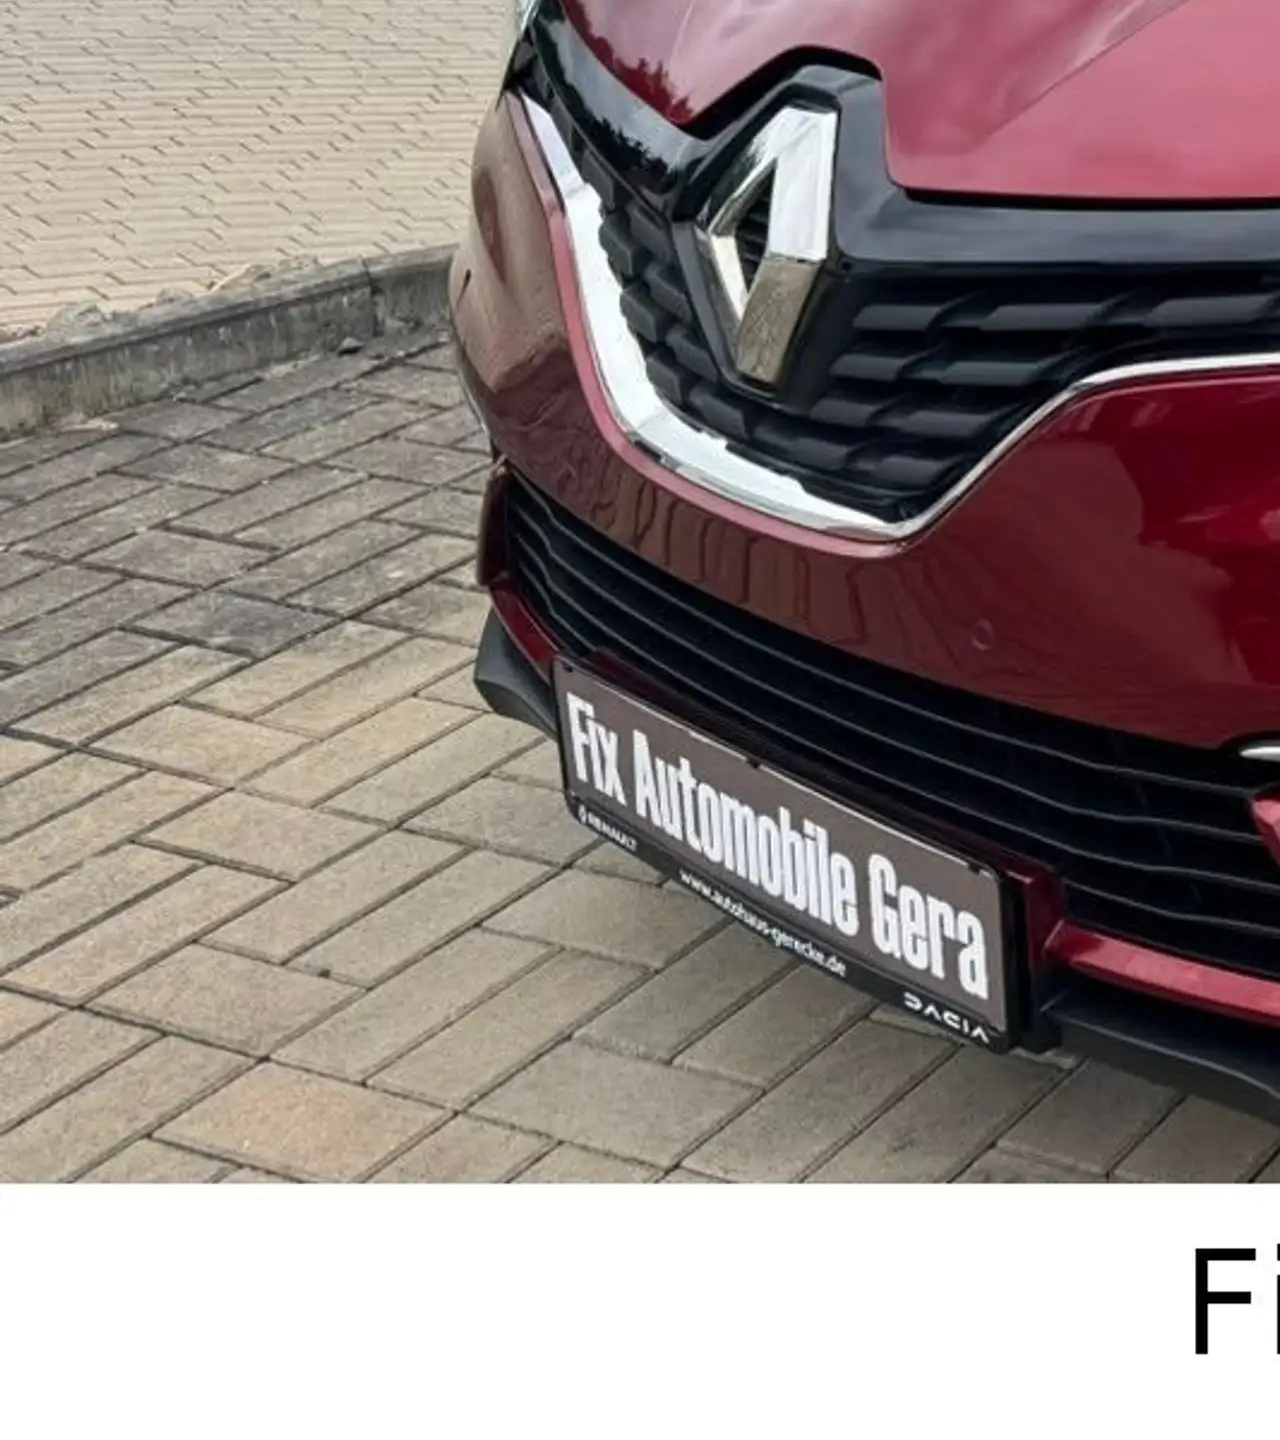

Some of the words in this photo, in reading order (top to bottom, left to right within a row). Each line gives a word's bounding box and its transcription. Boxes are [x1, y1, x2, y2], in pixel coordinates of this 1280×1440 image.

[567, 691, 627, 806] Fix
[633, 729, 860, 937] Automobile
[868, 853, 989, 1000] Gera
[903, 991, 990, 1044] DACIA
